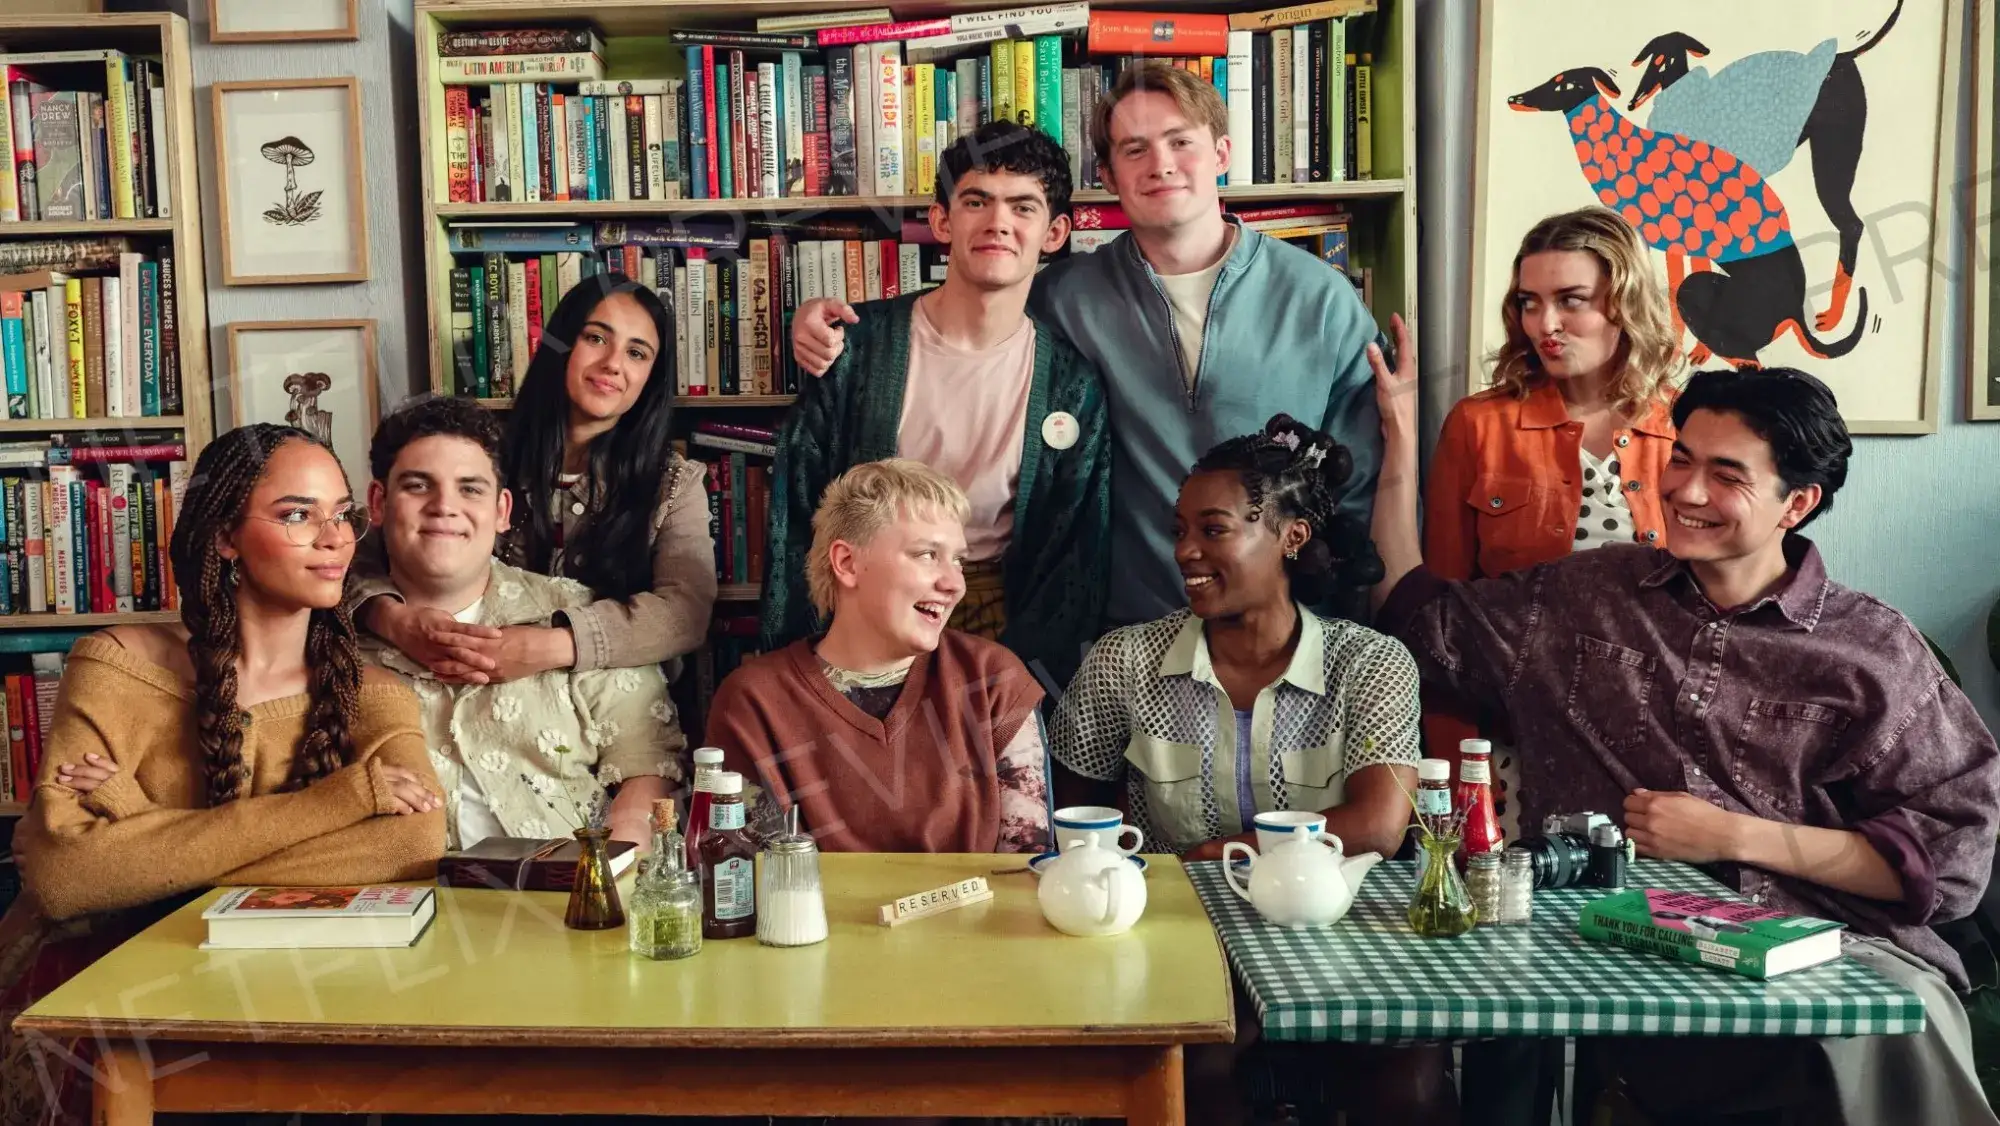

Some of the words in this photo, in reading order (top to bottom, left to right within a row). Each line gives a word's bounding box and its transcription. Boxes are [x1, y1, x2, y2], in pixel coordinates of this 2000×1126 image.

[967, 14, 994, 23] WILL
[999, 11, 1026, 20] FIND
[1030, 7, 1053, 17] YOU
[1277, 8, 1313, 21] origin
[488, 37, 510, 46] DESIRE
[1039, 40, 1049, 66] Saul
[464, 62, 487, 75] LATIN
[489, 61, 526, 75] AMERICA
[836, 57, 847, 74] the
[1279, 38, 1289, 97] Bloomsbury
[1336, 34, 1344, 77] illustration
[690, 69, 702, 91] Birds
[732, 63, 742, 95] DONNA
[881, 54, 896, 87] JOY
[1052, 75, 1058, 83] of
[1359, 70, 1367, 89] LITTLE
[759, 83, 771, 115] CHUCK
[833, 78, 849, 100] Map
[1039, 70, 1049, 106] Bellow
[40, 104, 70, 113] NANCY
[449, 96, 457, 127] THOMAS
[457, 92, 466, 129] SCARLETT
[734, 96, 743, 121] LEON
[1280, 100, 1289, 124] Girls
[1359, 90, 1367, 114] ELVISES
[41, 111, 71, 121] DREW
[575, 119, 584, 138] DAN
[631, 116, 639, 138] SCOTT
[691, 100, 703, 131] Winter
[750, 116, 758, 148] JORDAN
[835, 117, 850, 145] Chaos
[575, 140, 586, 175] BROWN
[632, 139, 640, 163] FROST
[761, 119, 775, 177] PALAHNIUK
[452, 162, 468, 170] END
[633, 165, 641, 183] NEVER
[651, 152, 659, 188] LIFELINE
[880, 147, 890, 179] LAHR
[634, 183, 642, 197] FEAR
[162, 258, 171, 289] SAUCES
[690, 264, 704, 290] Enter
[848, 248, 859, 285] HUCK
[489, 273, 498, 300] BOYLE
[164, 298, 173, 330] SHAPES
[691, 291, 705, 317] Ghost
[753, 278, 768, 349] SLAB
[67, 303, 80, 345] FOXY-T
[143, 328, 153, 385] EVERYDAY
[30, 486, 39, 511] FOOD
[111, 468, 126, 536] REQIEM
[144, 482, 153, 500] Karl
[711, 495, 719, 535] BROKEN
[59, 570, 67, 595] MYERS
[898, 880, 979, 913] RESERVED
[1593, 914, 1620, 930] THANK
[1620, 919, 1638, 934] YOU
[1639, 923, 1656, 938] FOR
[1657, 927, 1695, 948] CALLING
[1608, 932, 1625, 944] THE
[1659, 942, 1680, 957] LINE
